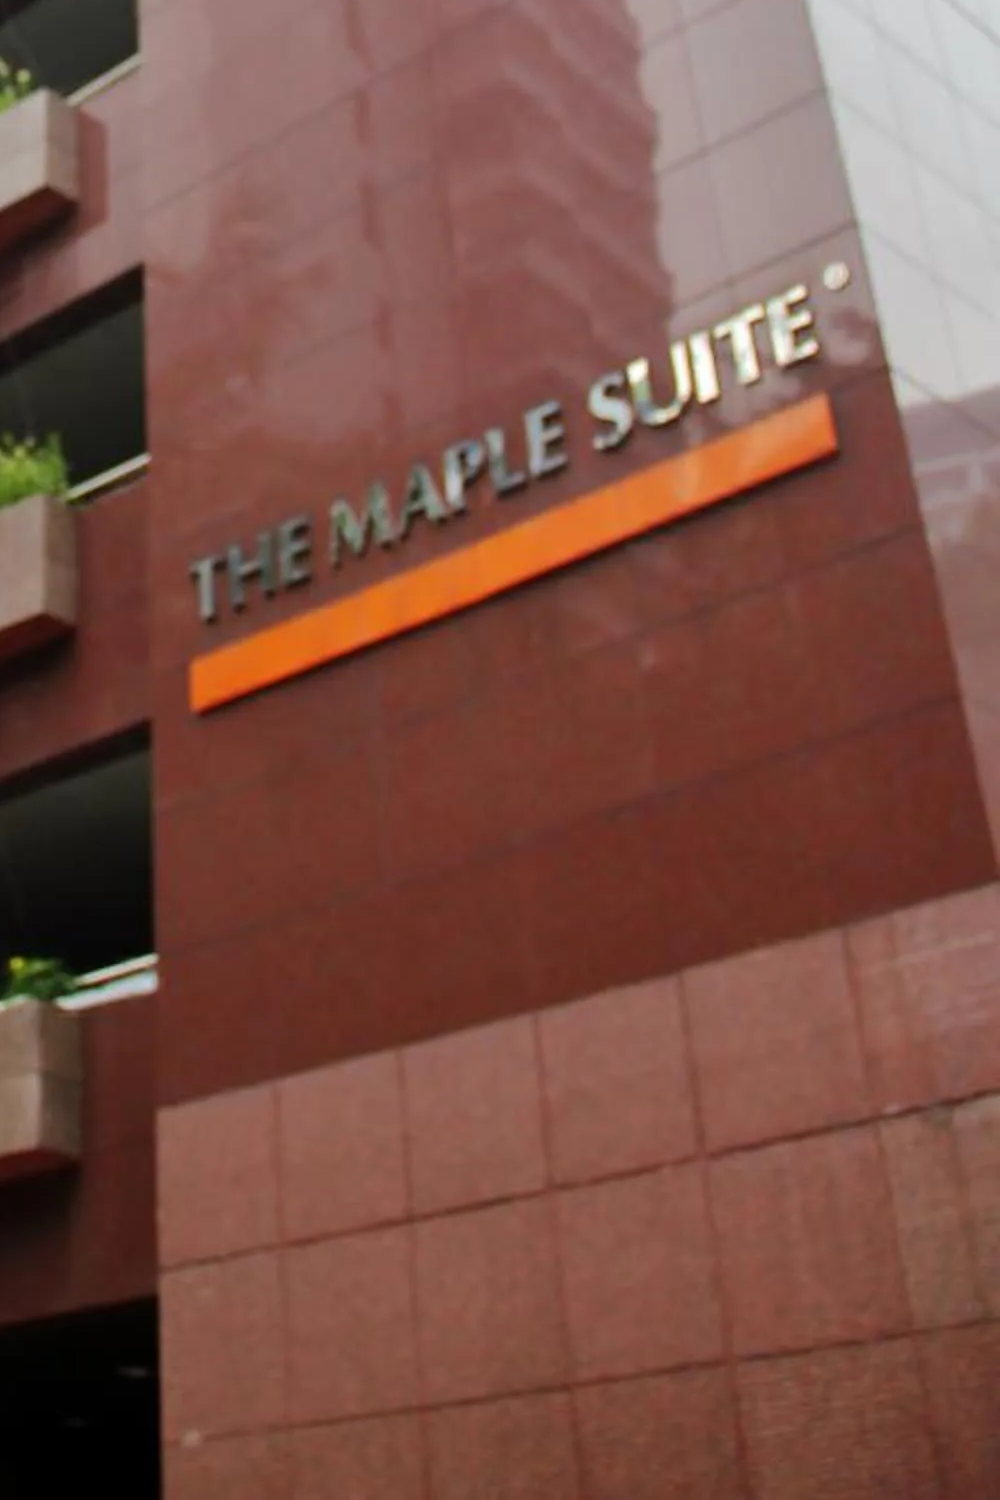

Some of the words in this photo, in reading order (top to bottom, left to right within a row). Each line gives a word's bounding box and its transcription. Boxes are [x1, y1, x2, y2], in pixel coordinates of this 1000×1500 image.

[190, 515, 310, 621] THE
[329, 401, 568, 566] MAPLE
[586, 285, 819, 450] SUITE
